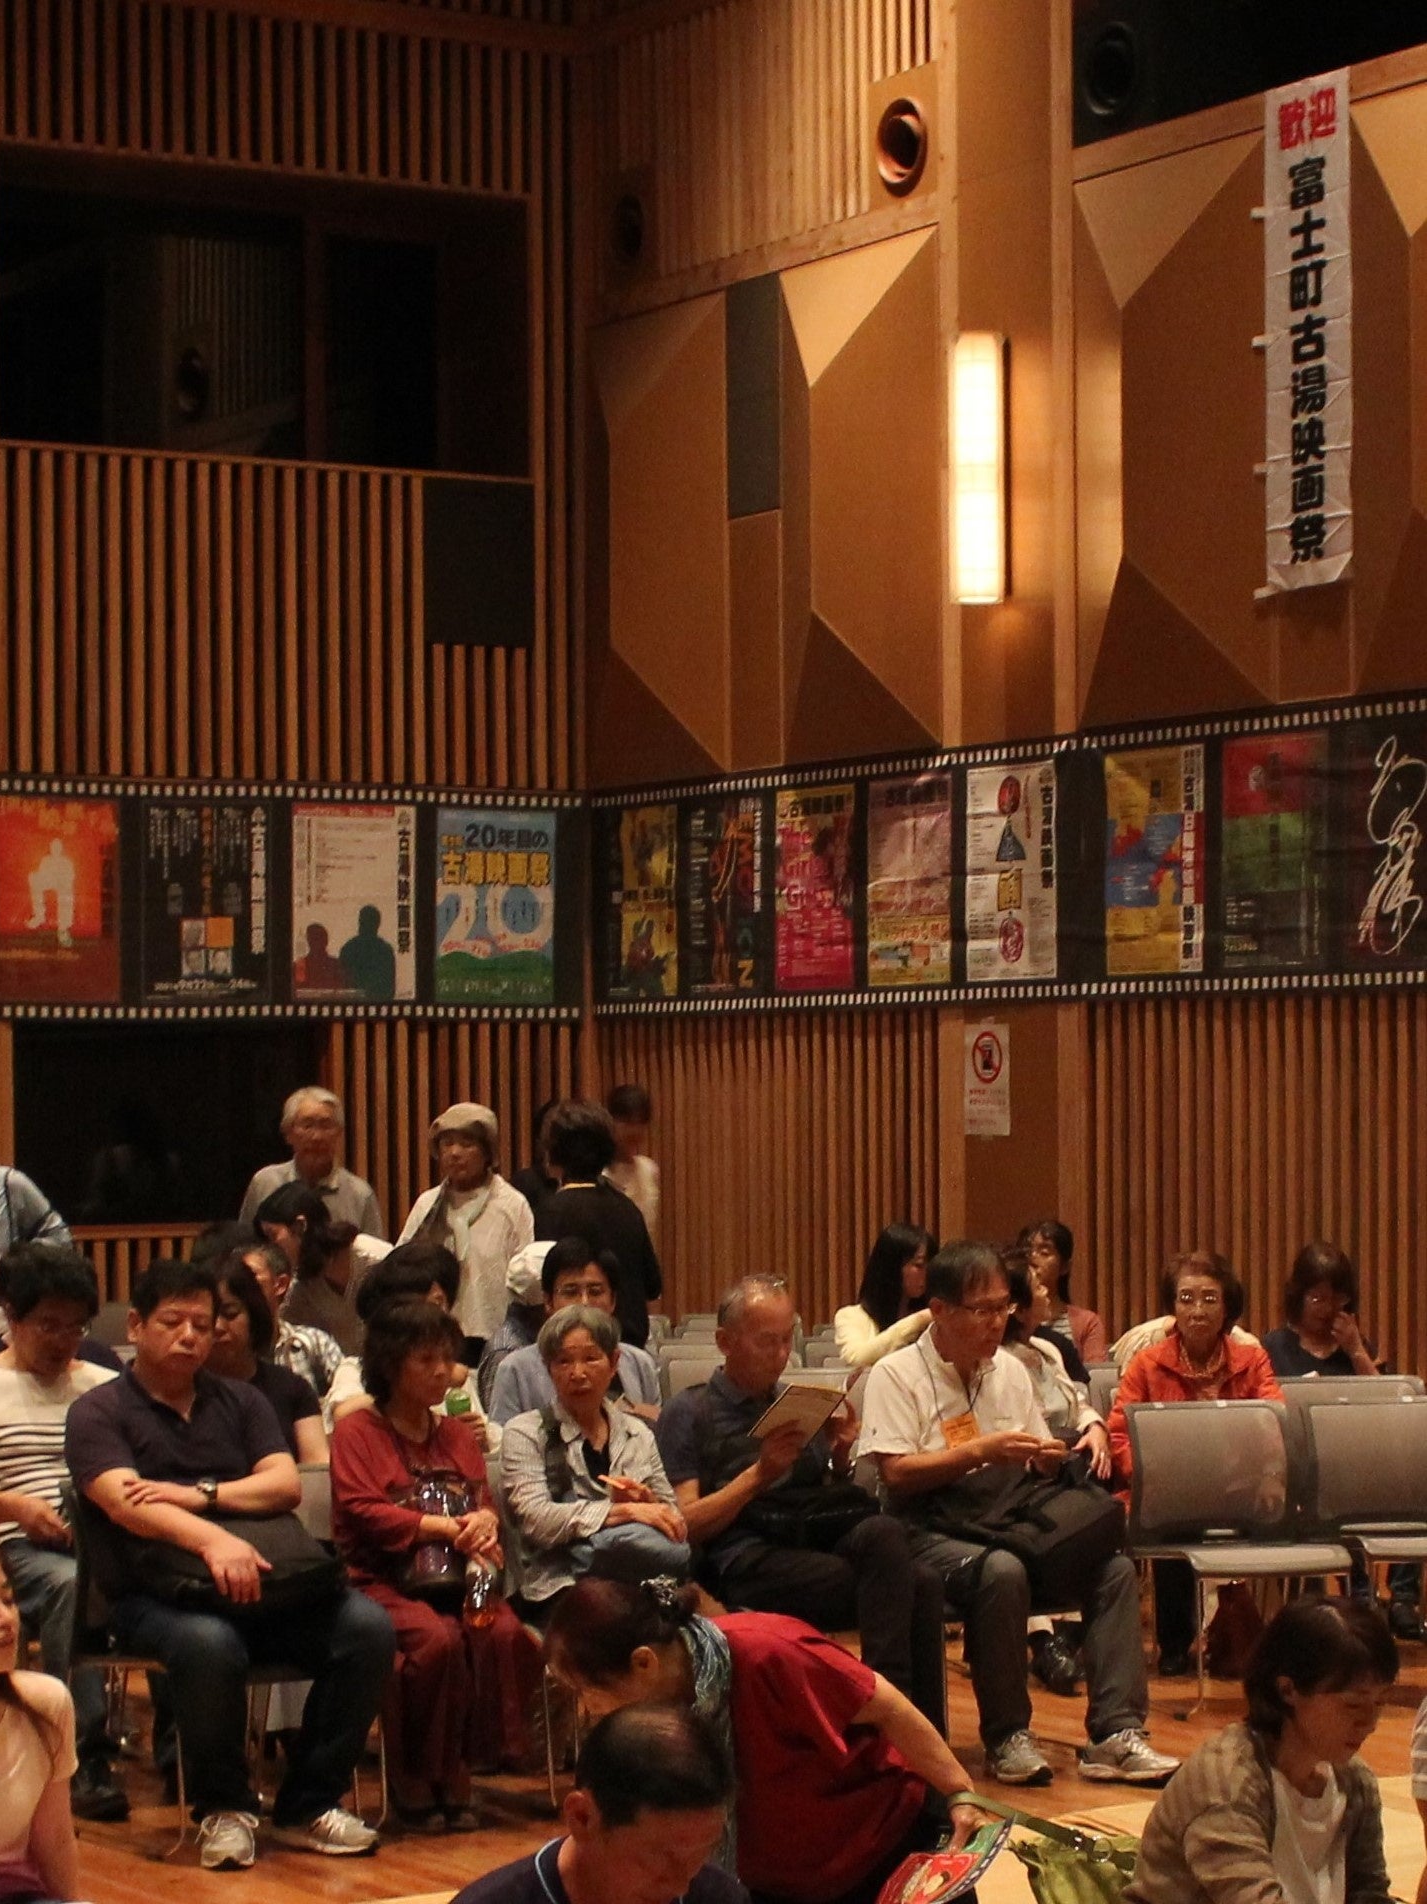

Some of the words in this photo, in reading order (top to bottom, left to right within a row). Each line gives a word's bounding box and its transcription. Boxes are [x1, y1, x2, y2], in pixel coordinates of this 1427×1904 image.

[1279, 87, 1336, 151] 歓迎
[1288, 155, 1328, 565] 富士町古湯映画祭
